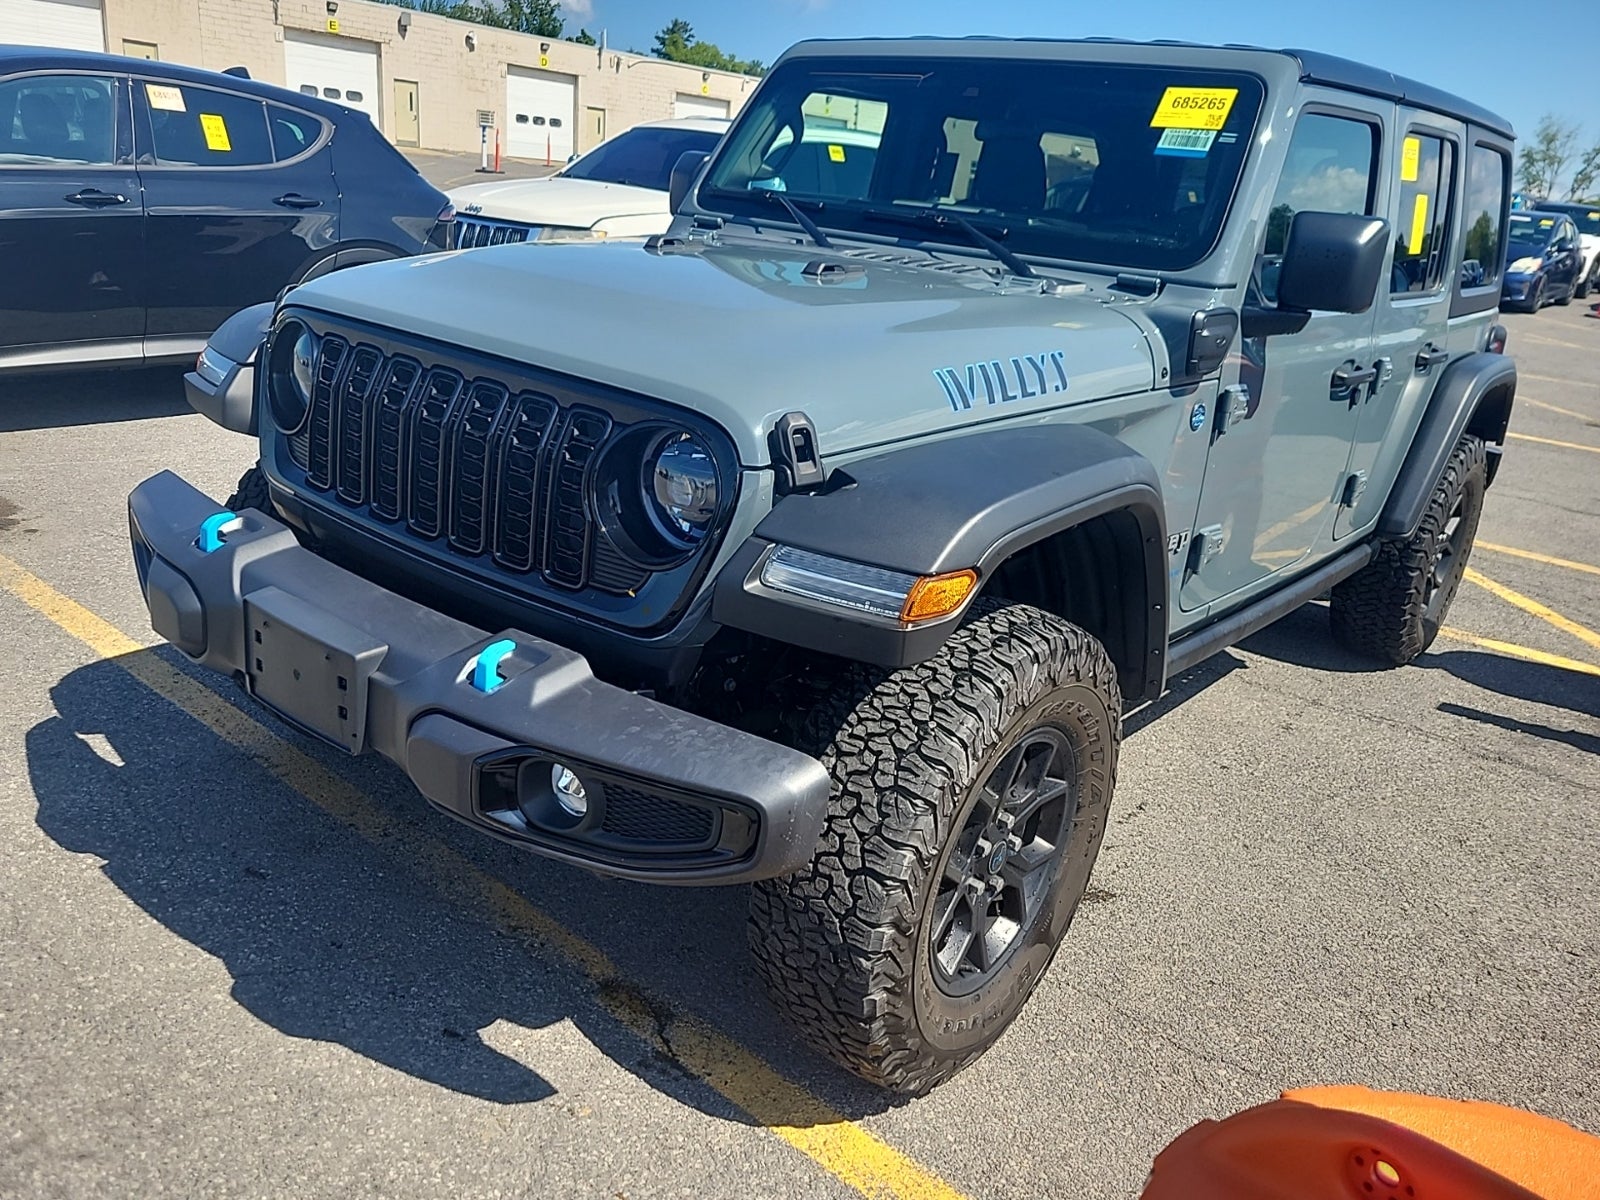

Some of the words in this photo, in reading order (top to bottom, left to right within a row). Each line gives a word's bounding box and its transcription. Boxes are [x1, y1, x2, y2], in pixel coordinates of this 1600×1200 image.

[329, 20, 337, 30] E
[541, 57, 548, 67] D
[1171, 96, 1227, 110] 685265
[933, 350, 1067, 412] WILLYS
